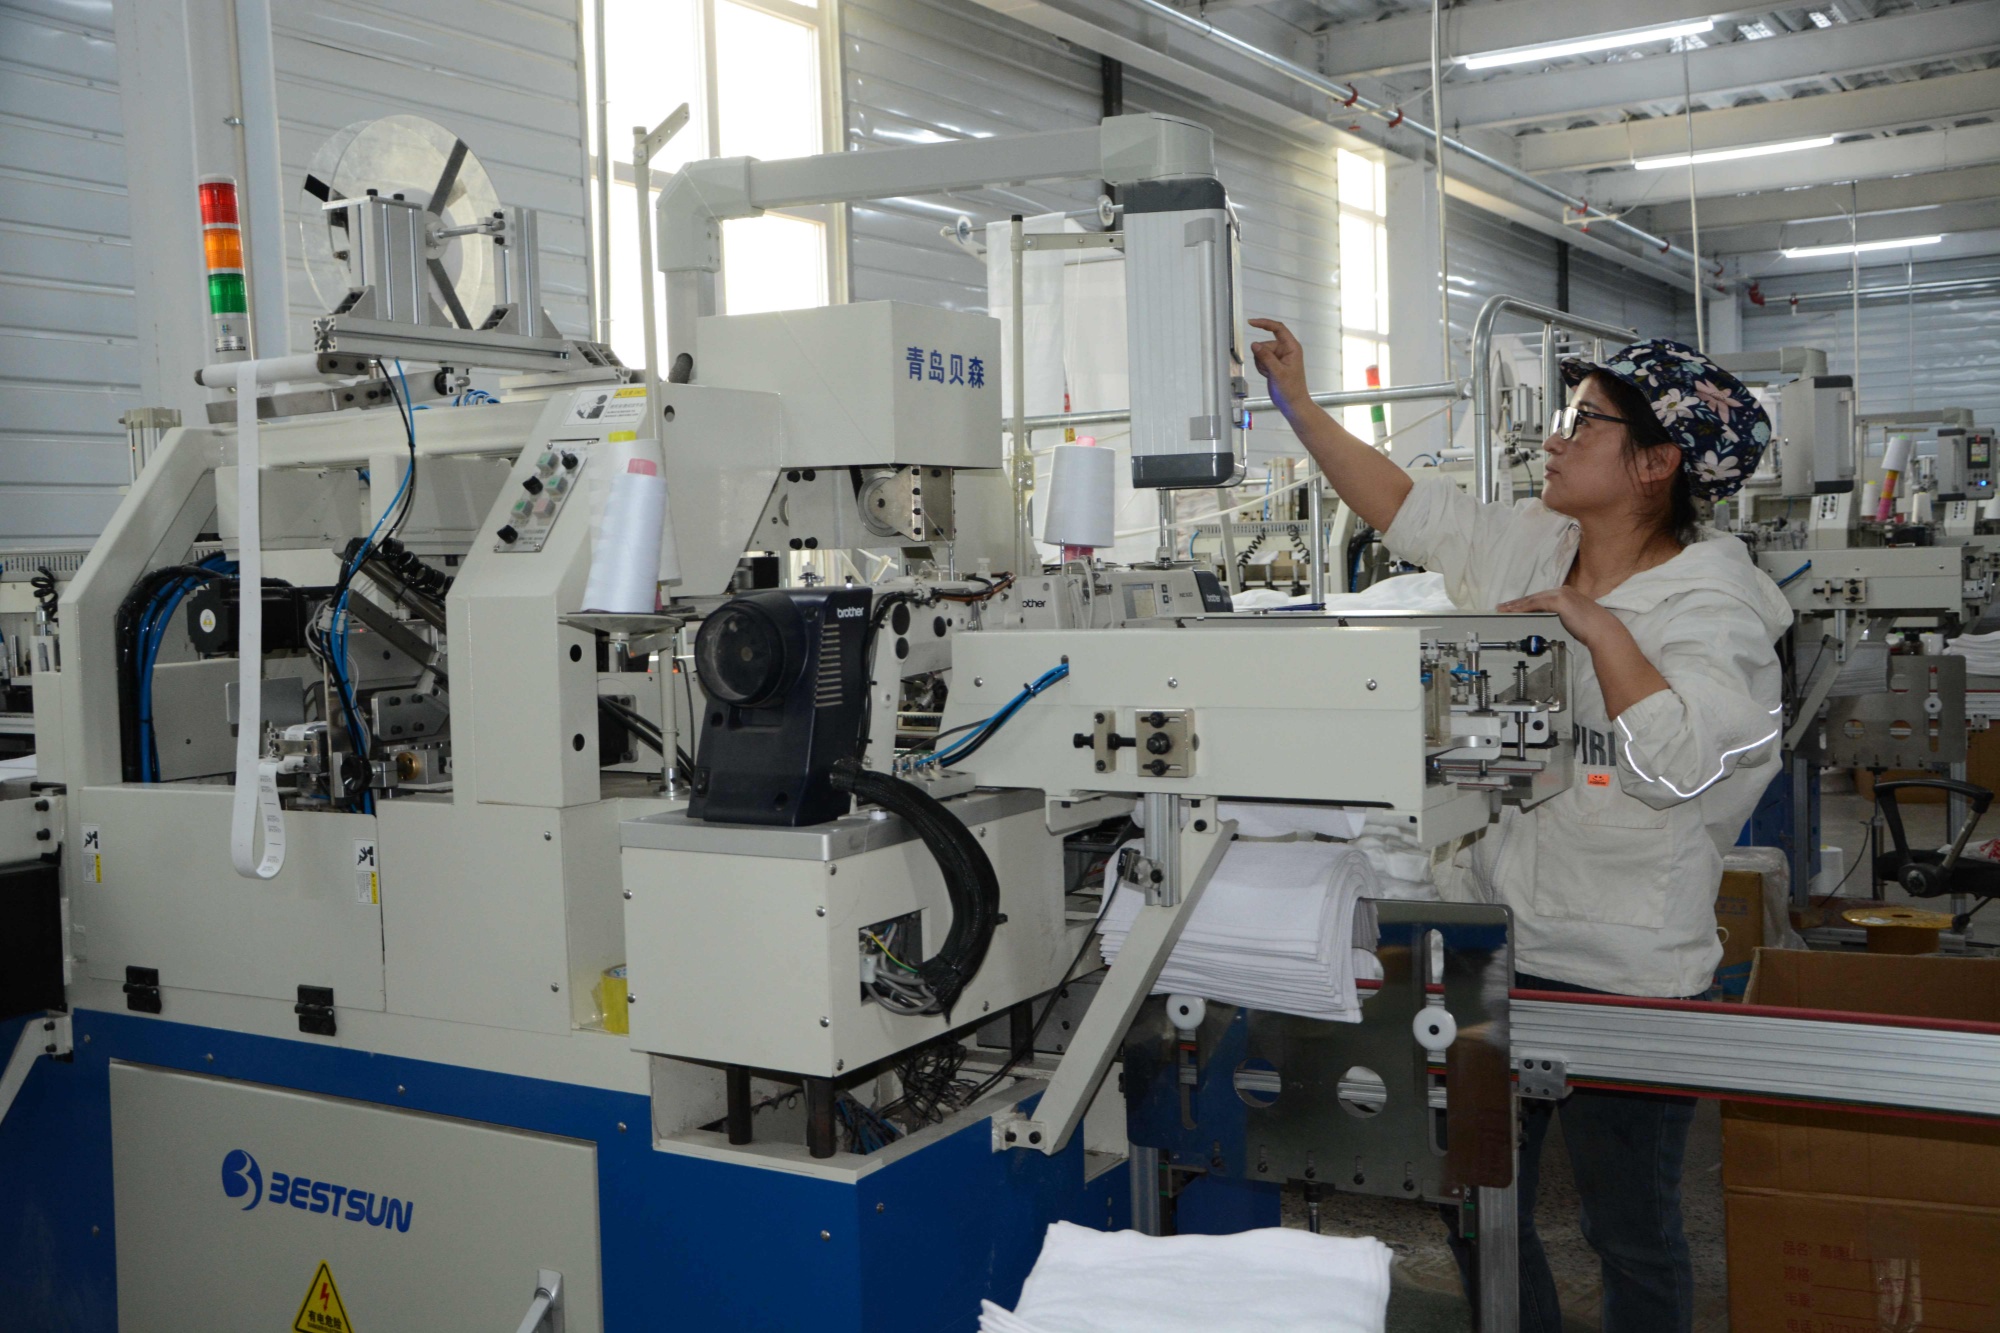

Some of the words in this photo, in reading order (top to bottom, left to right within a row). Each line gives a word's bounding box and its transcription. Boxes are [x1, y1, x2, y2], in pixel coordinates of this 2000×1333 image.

[906, 346, 985, 389] 青岛贝森
[836, 607, 864, 619] brother
[268, 1171, 414, 1234] BESTSUN
[308, 1310, 342, 1330] 有电危险
